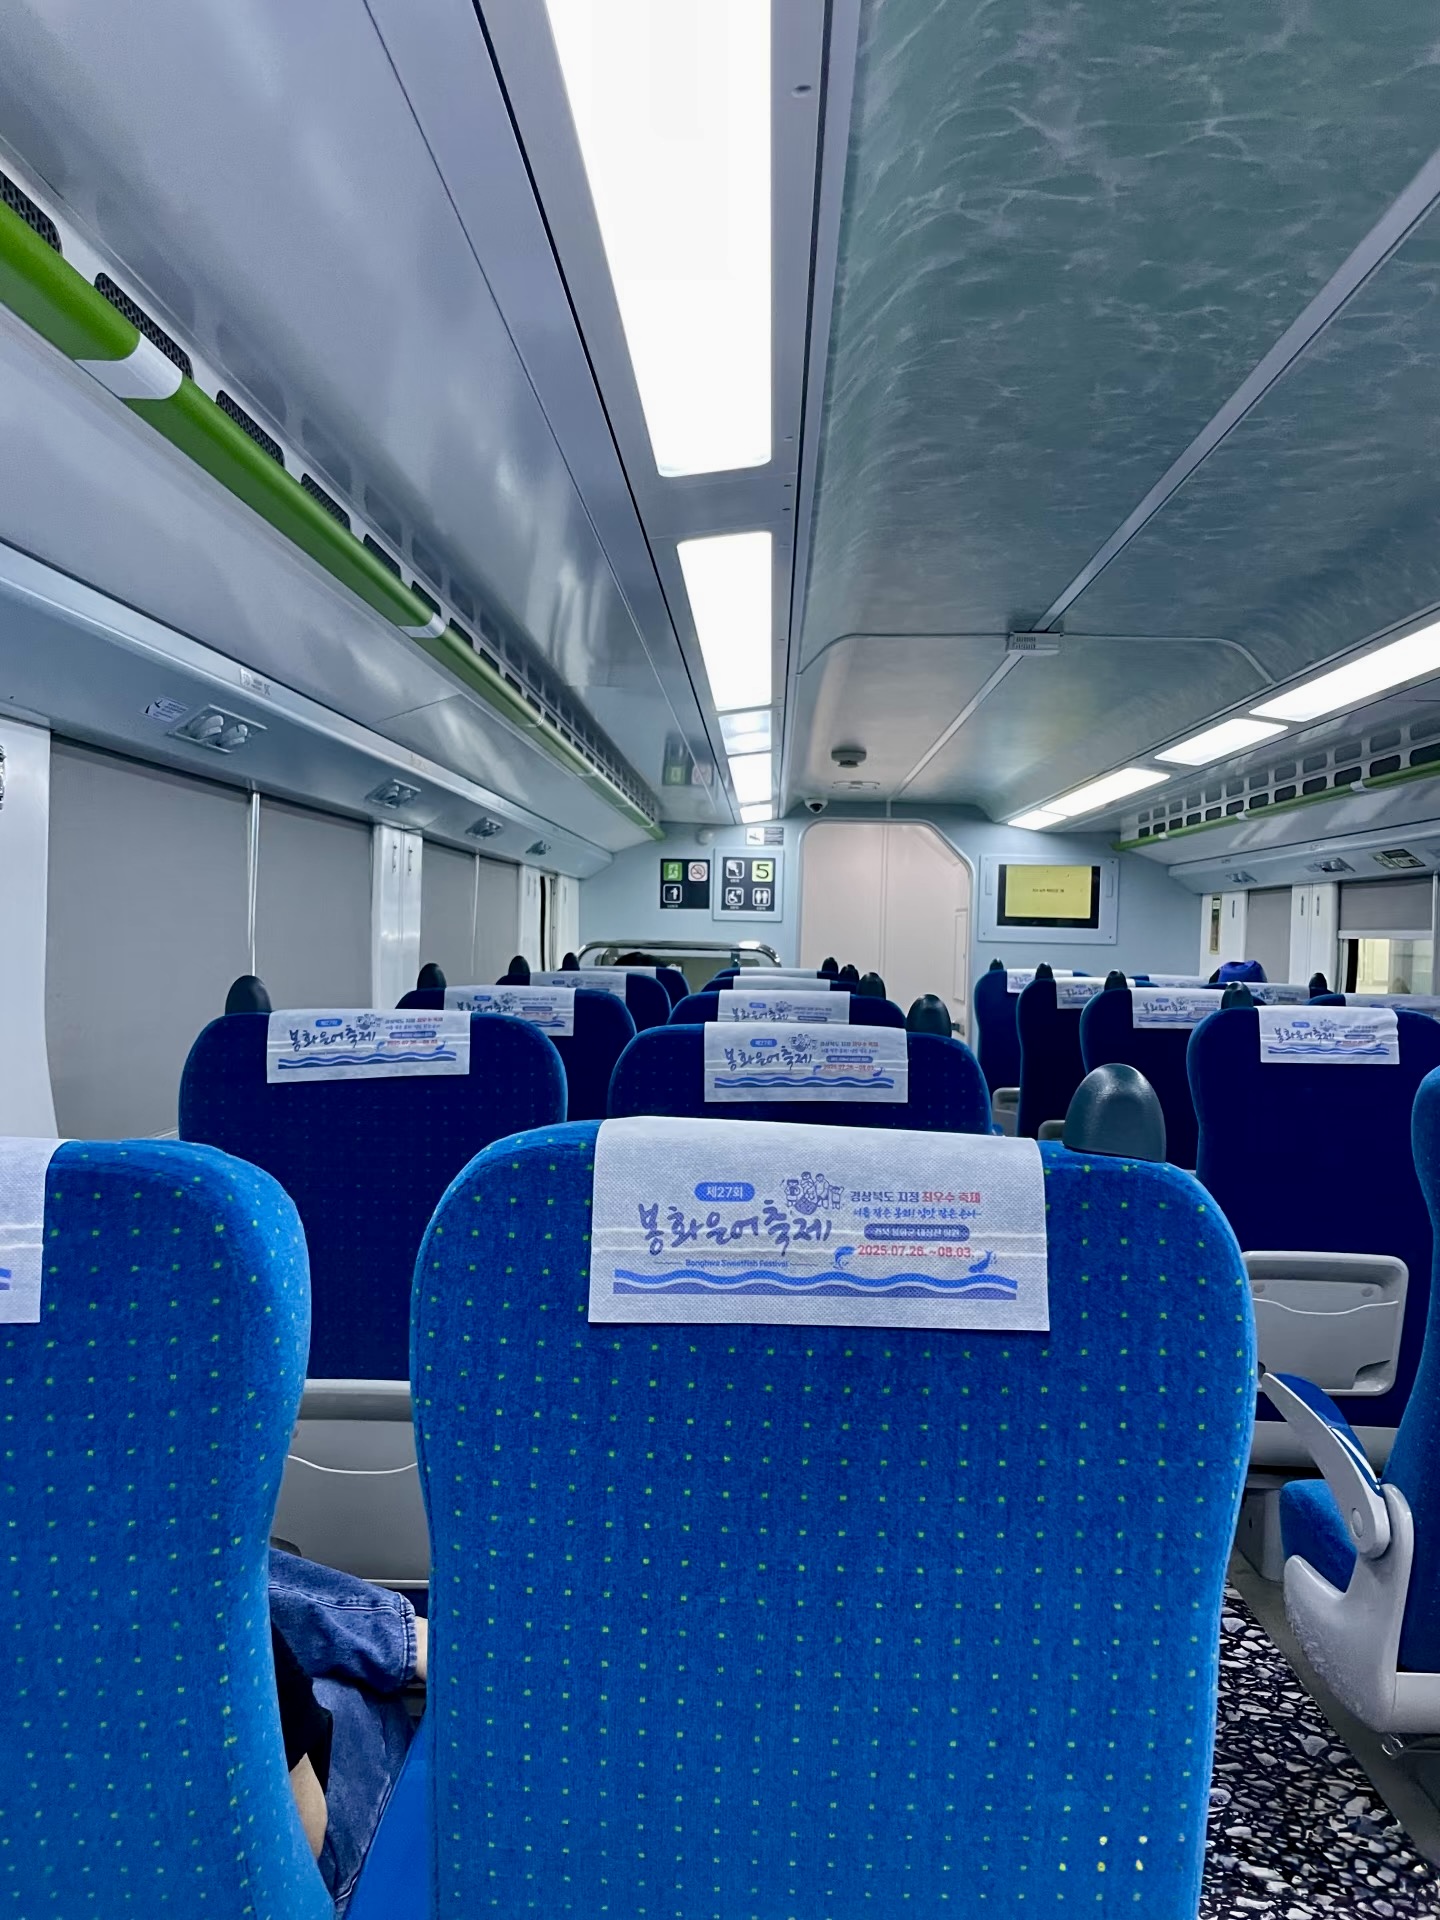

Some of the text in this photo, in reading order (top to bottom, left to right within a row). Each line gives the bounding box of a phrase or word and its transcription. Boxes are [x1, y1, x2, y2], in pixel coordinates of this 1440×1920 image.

[756, 863, 769, 880] 5
[706, 1186, 744, 1199] 제27회
[849, 1190, 894, 1203] 경상북도
[638, 1200, 832, 1257] 봉화은어축제
